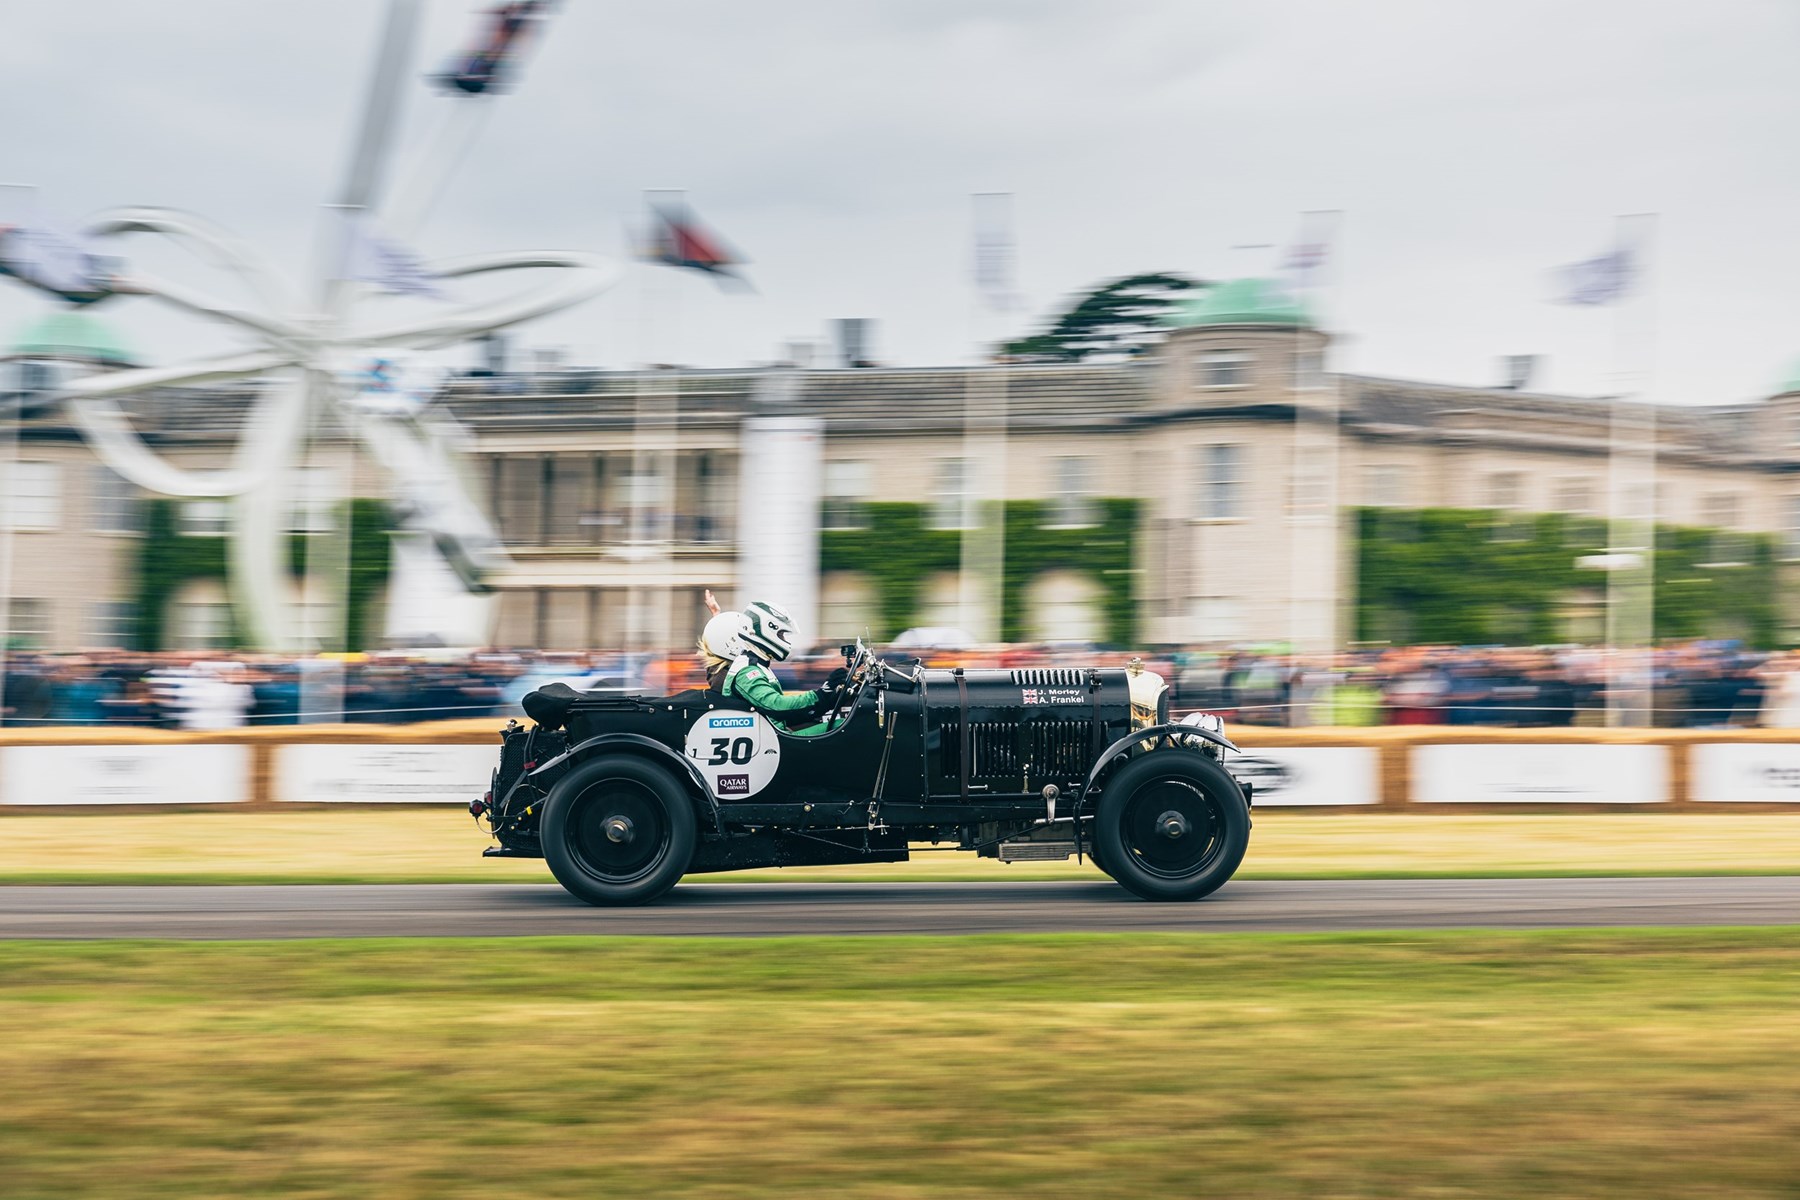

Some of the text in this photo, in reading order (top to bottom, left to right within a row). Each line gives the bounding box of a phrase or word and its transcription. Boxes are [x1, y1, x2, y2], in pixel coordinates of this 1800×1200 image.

[1051, 696, 1084, 704] Frankel
[712, 718, 750, 727] aramco
[708, 737, 754, 766] 30
[720, 779, 747, 788] QATAR
